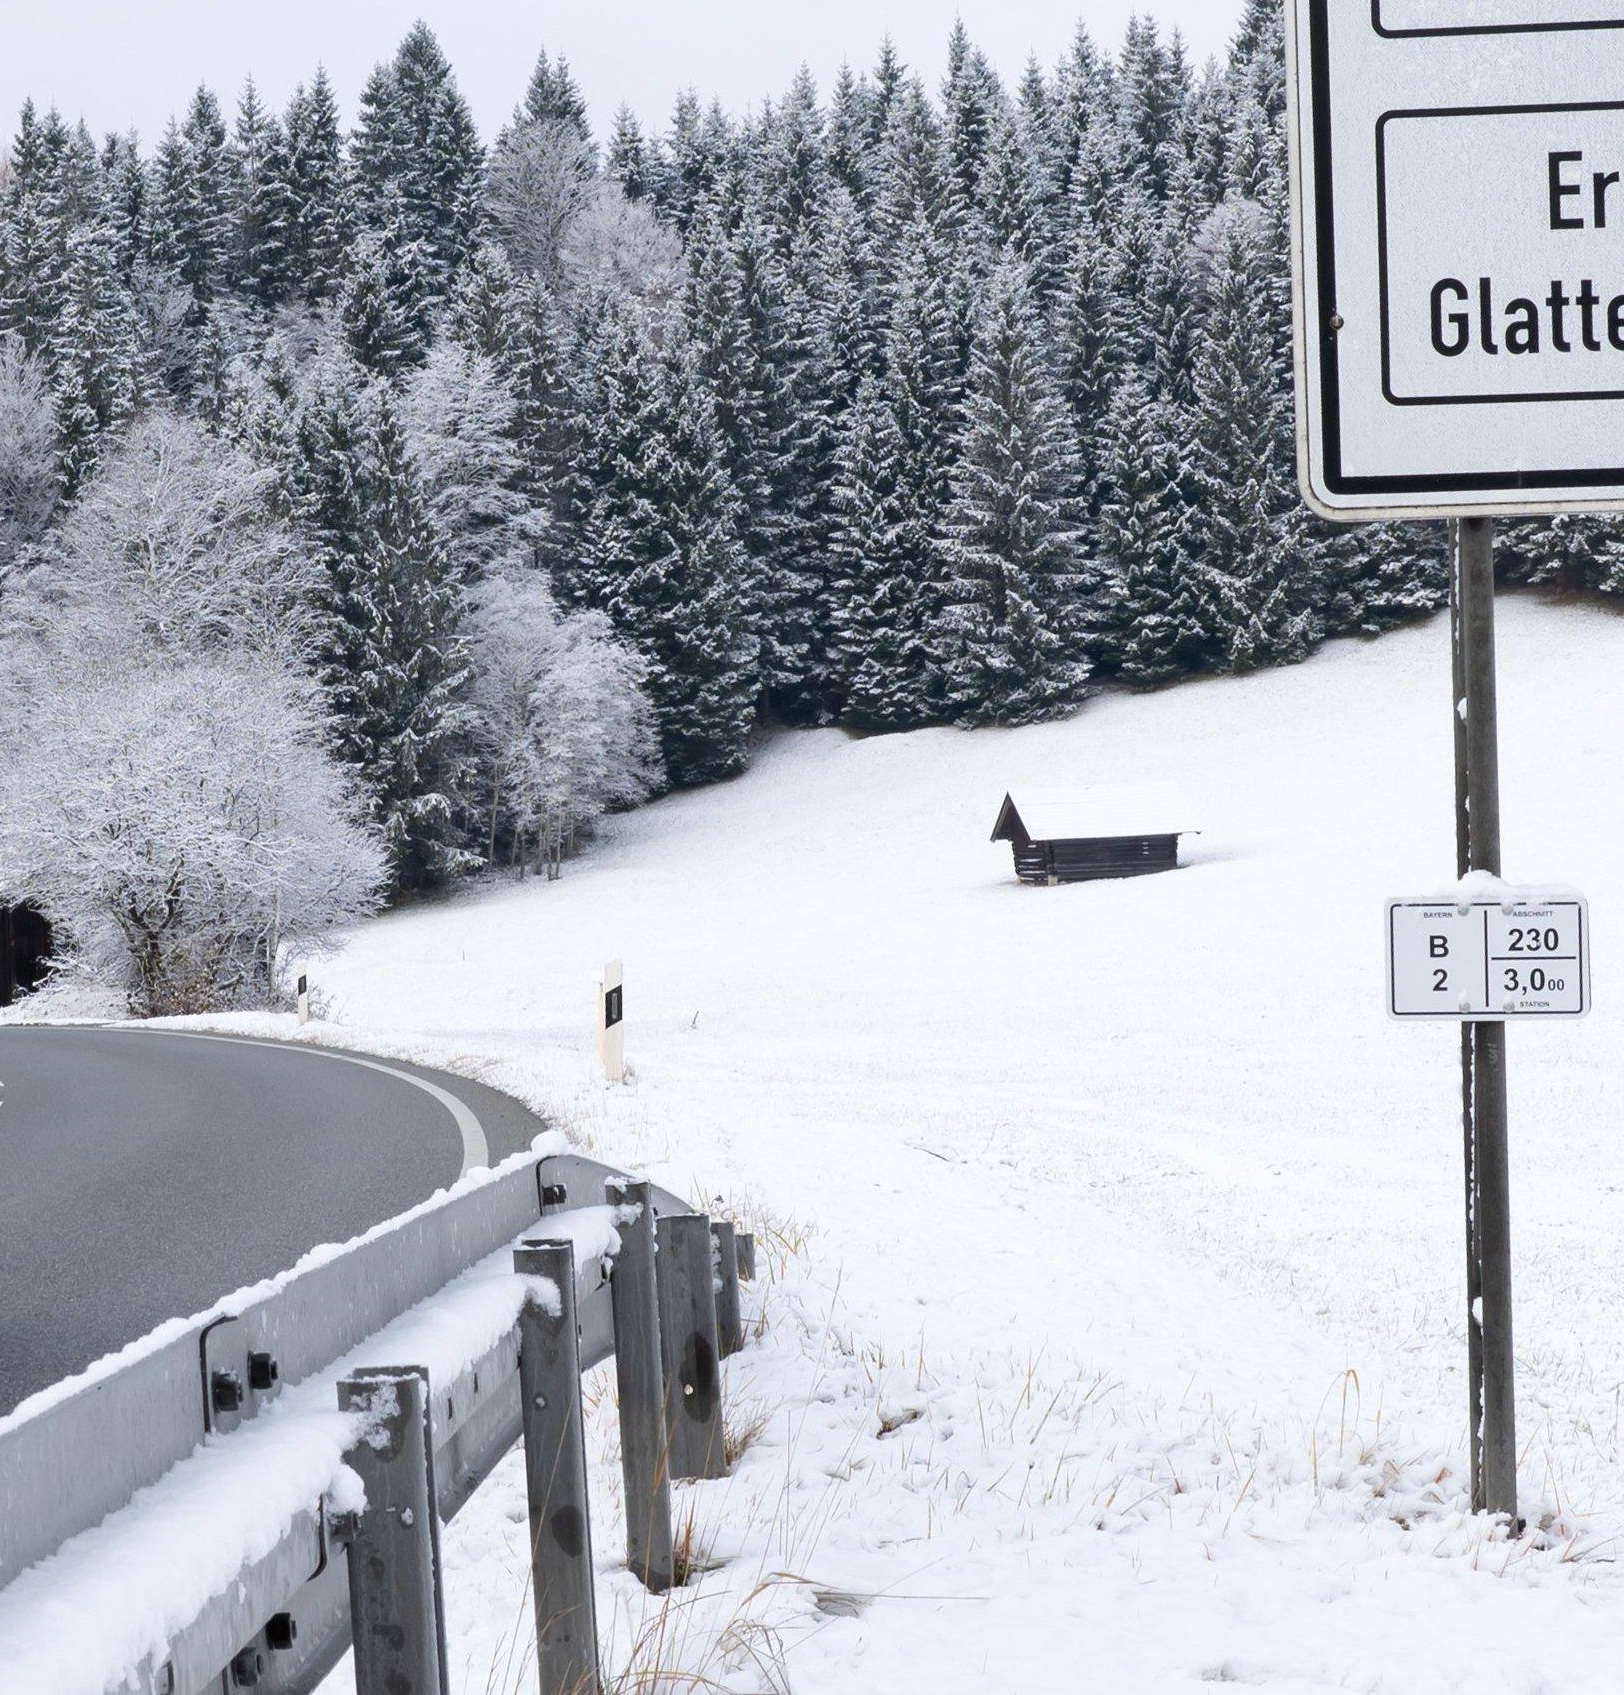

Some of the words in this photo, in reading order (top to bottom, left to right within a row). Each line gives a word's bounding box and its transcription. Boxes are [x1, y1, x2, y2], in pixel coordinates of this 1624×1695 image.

[1429, 935, 1449, 958] B
[1508, 928, 1559, 952] 230
[1432, 968, 1448, 992] 2
